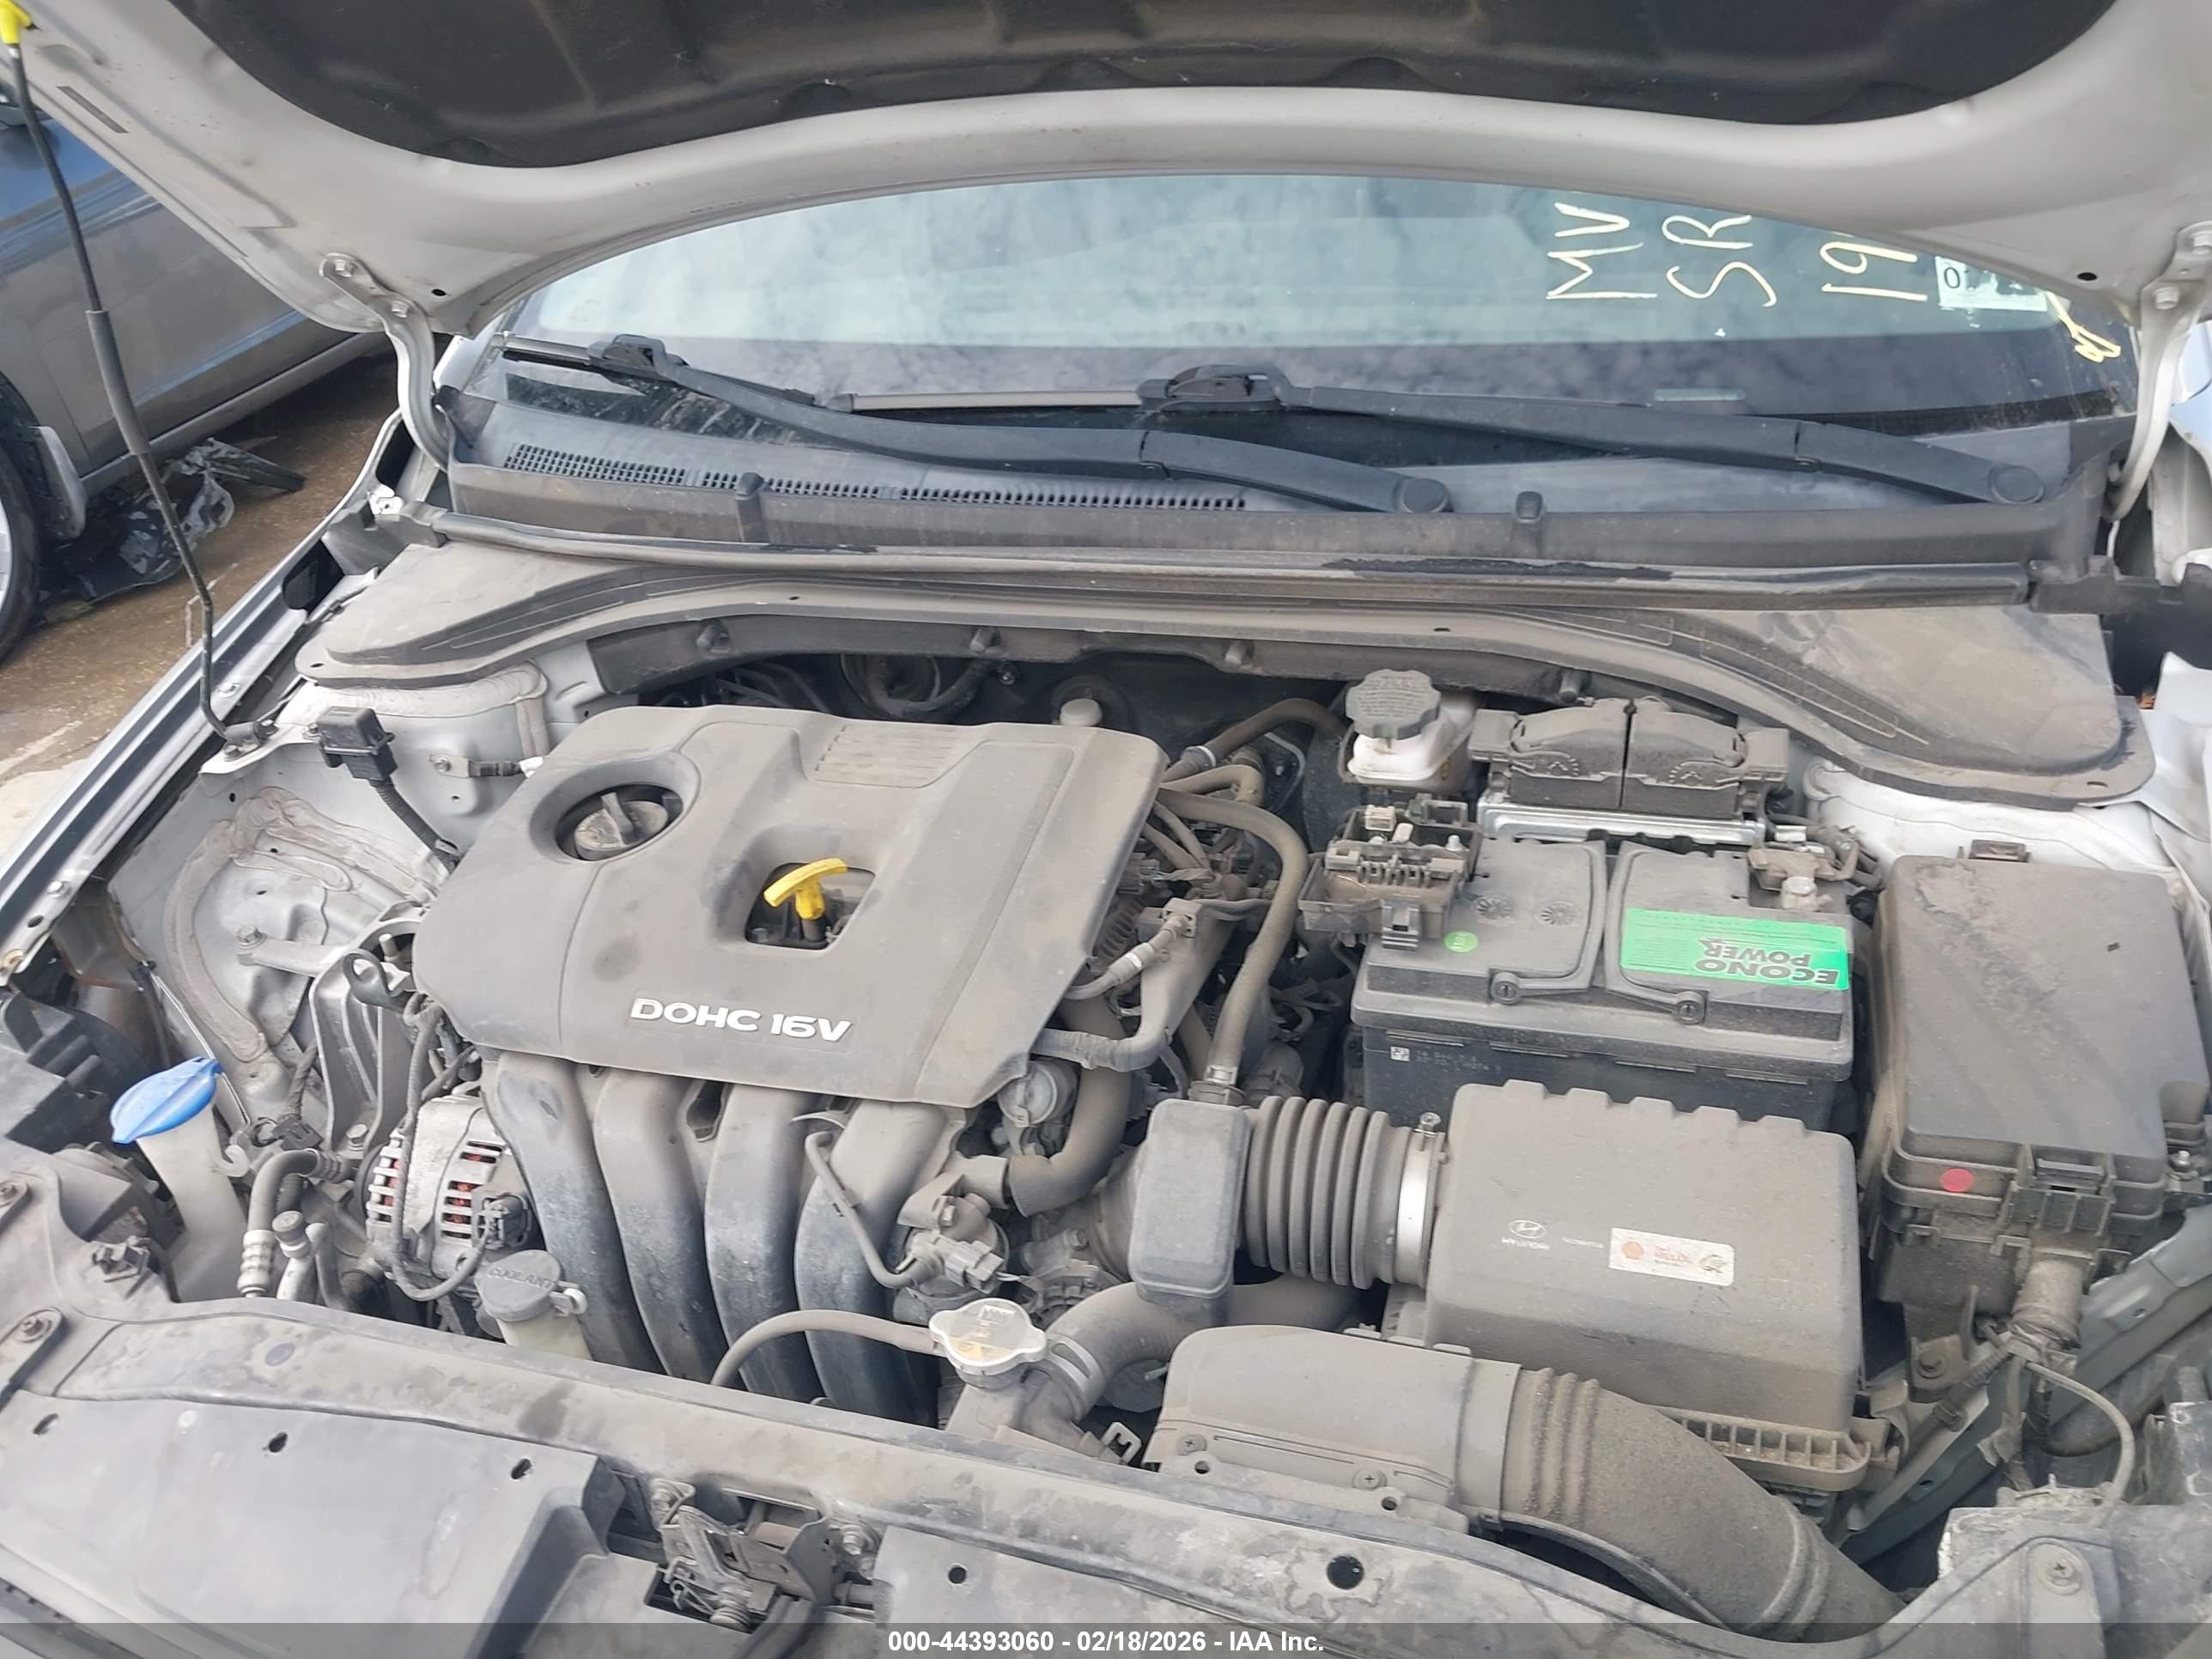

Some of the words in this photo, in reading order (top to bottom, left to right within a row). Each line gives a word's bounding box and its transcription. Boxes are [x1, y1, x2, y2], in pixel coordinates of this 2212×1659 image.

[1546, 203, 1658, 301] MV
[1662, 215, 1777, 307] SR
[1819, 232, 1928, 301] 19
[1695, 958, 1840, 985] ECONO
[1698, 939, 1812, 968] POWER
[630, 998, 762, 1031] DOHC
[770, 1013, 852, 1042] 16V
